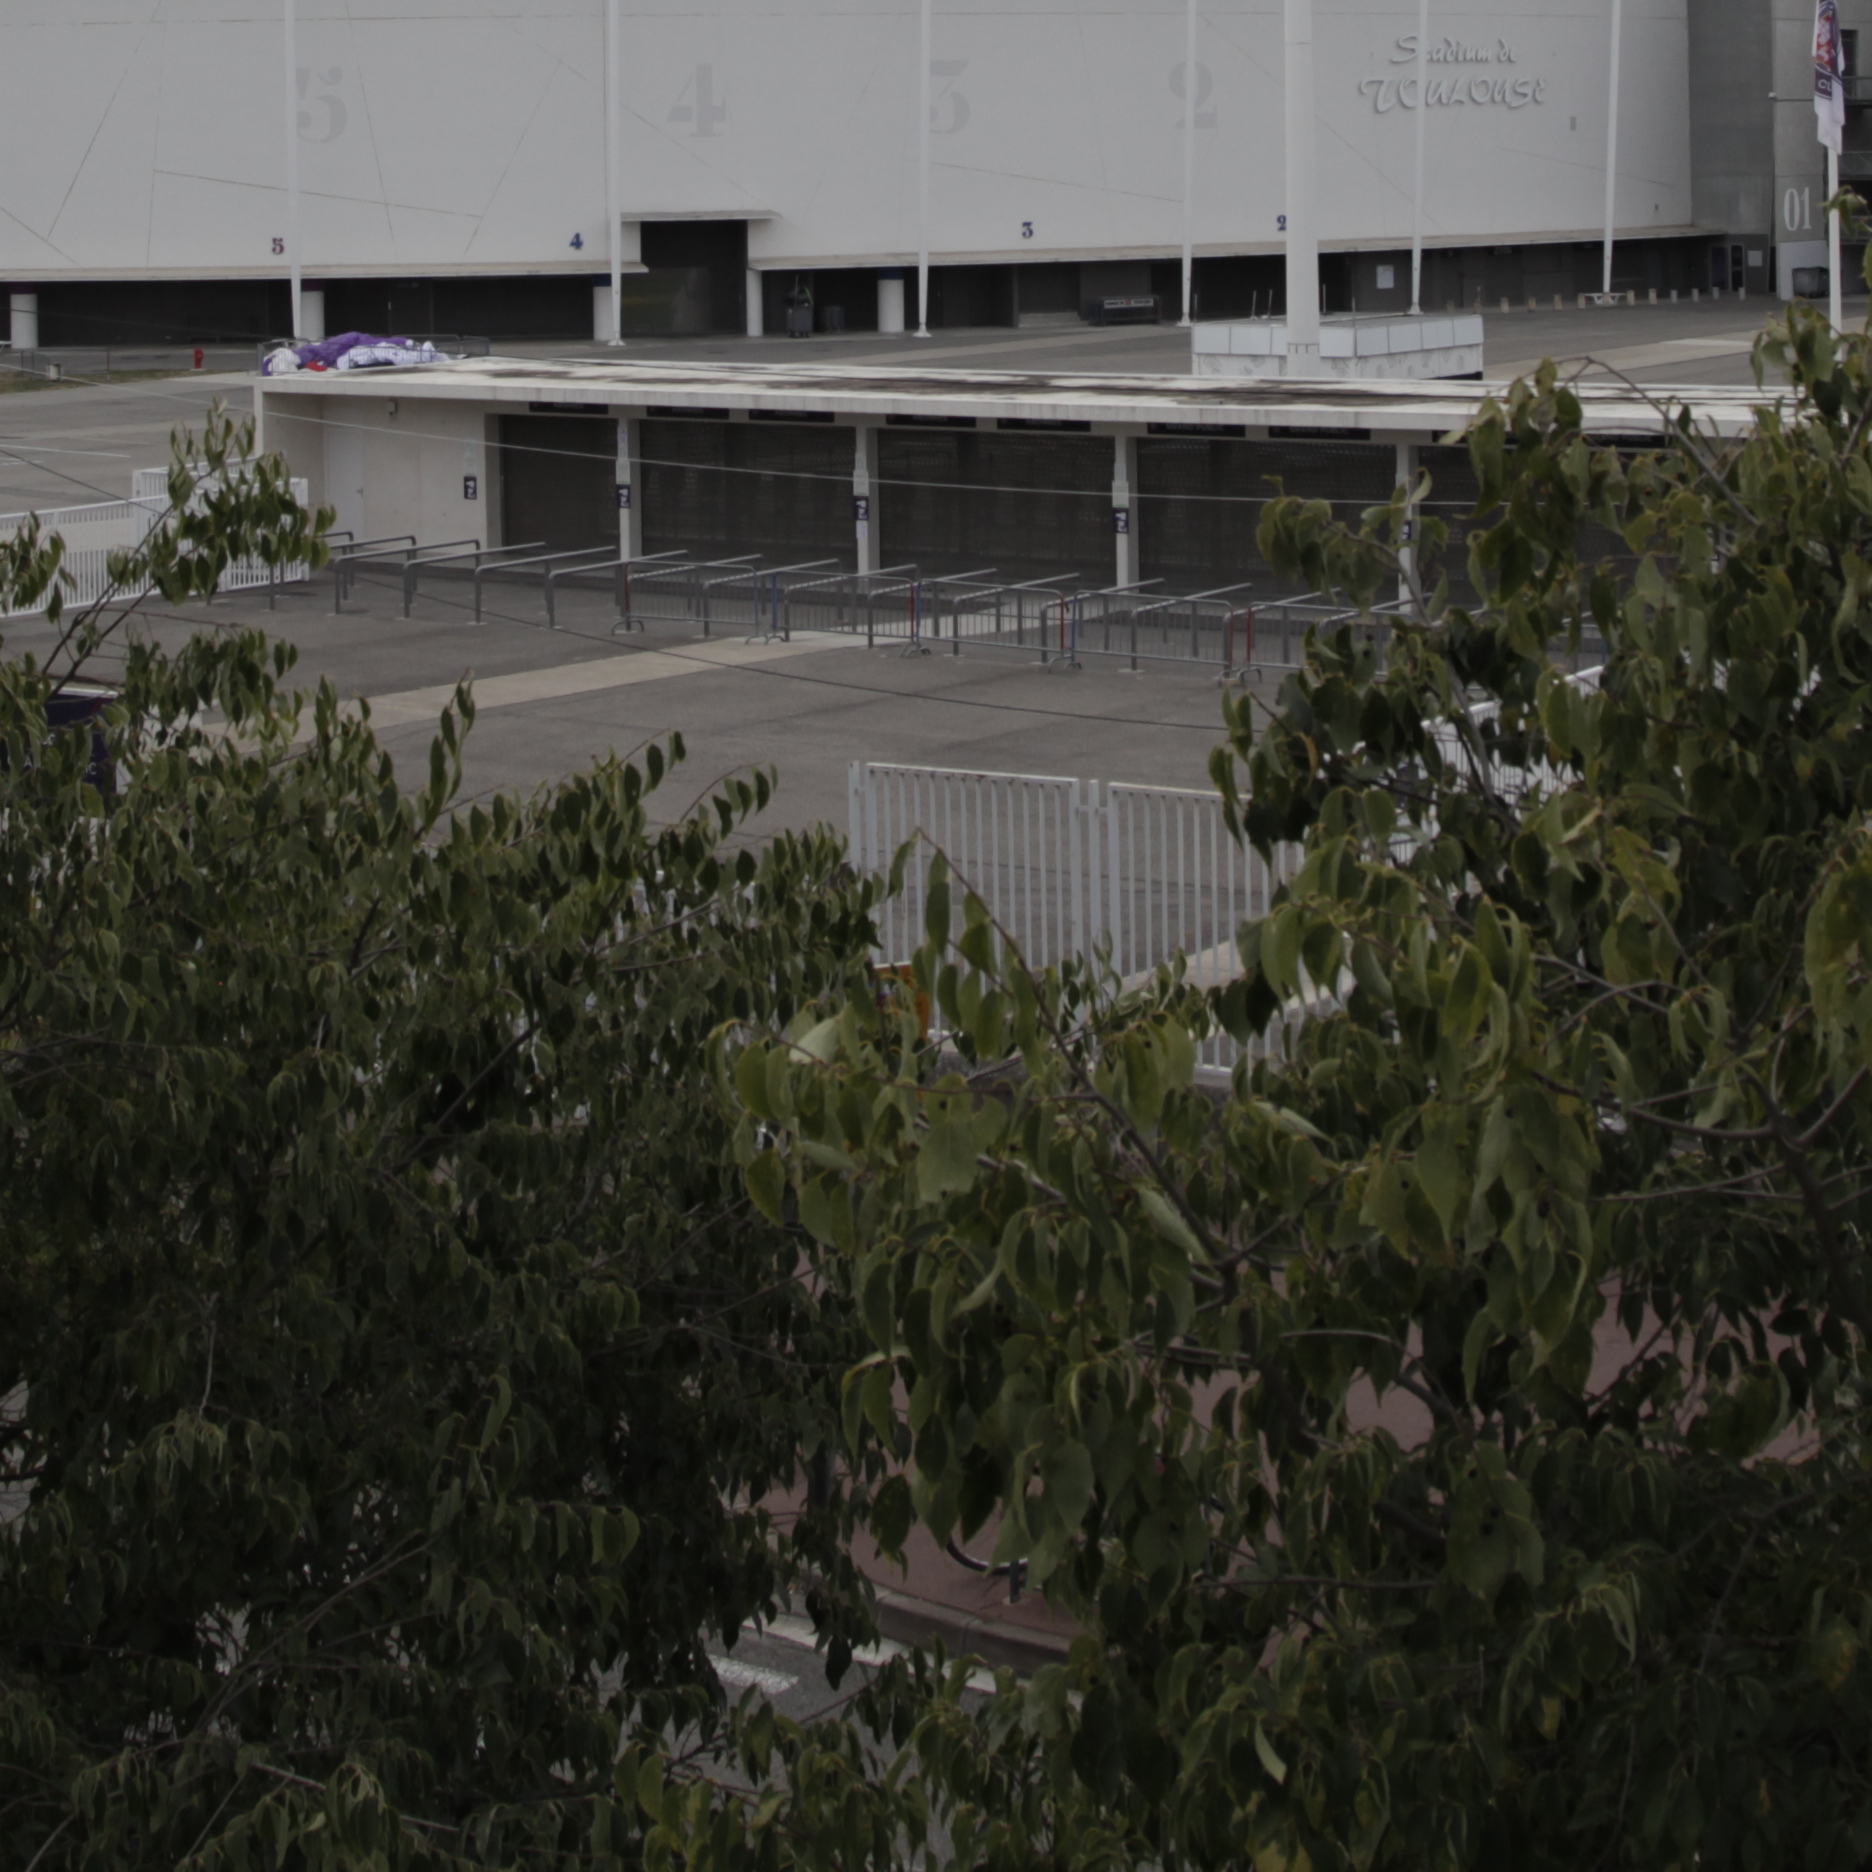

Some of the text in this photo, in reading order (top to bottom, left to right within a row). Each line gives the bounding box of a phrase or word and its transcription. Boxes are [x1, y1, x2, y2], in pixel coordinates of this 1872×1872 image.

[295, 67, 347, 144] 5
[665, 63, 728, 138] 4
[928, 60, 970, 135] 3
[1169, 60, 1219, 129] 2
[1021, 221, 1034, 239] 3
[1276, 214, 1287, 232] 2
[1783, 186, 1812, 232] 01
[272, 236, 285, 256] 5
[569, 232, 584, 250] 4
